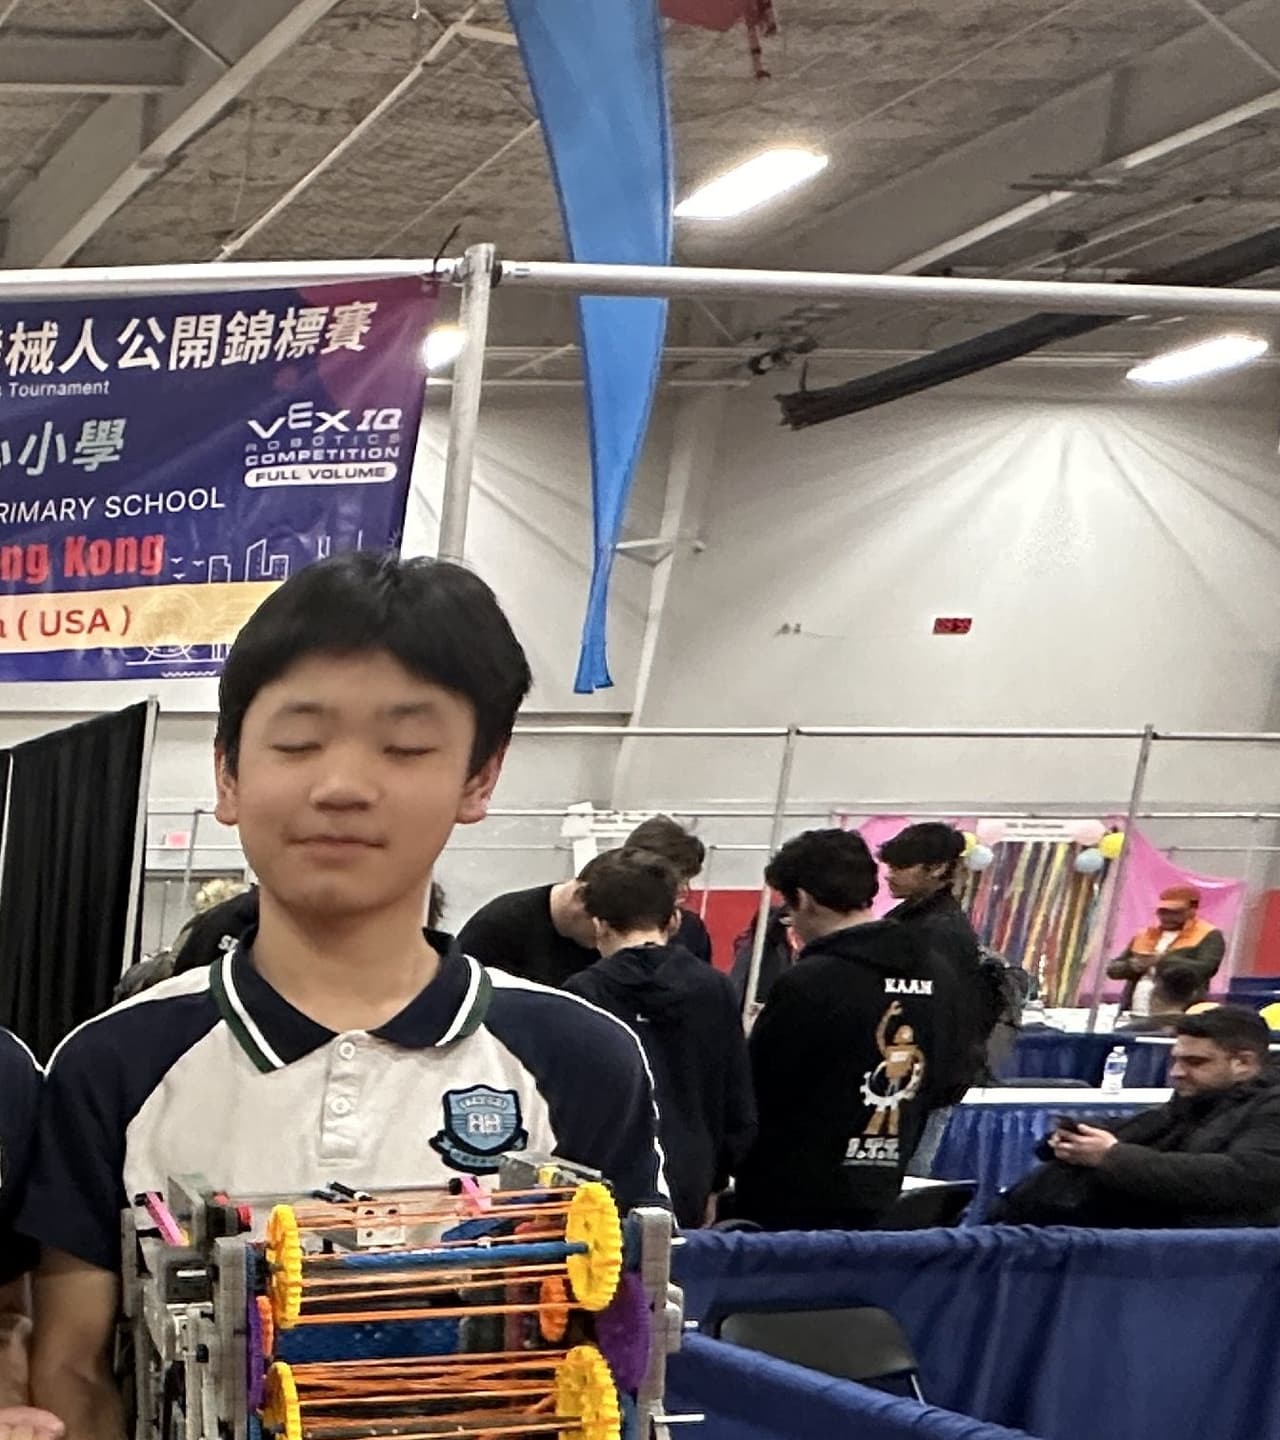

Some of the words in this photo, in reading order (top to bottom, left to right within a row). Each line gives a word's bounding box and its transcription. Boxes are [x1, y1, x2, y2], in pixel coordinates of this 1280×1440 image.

[8, 380, 111, 398] Tournament
[247, 401, 351, 439] VEX
[356, 407, 403, 431] IQ
[244, 433, 401, 453] ROBOTICS
[244, 447, 401, 467] COMPETITION
[255, 470, 301, 483] FULL
[308, 467, 387, 480] VOLUME
[104, 486, 226, 519] SCHOOL
[63, 533, 166, 579] Kong
